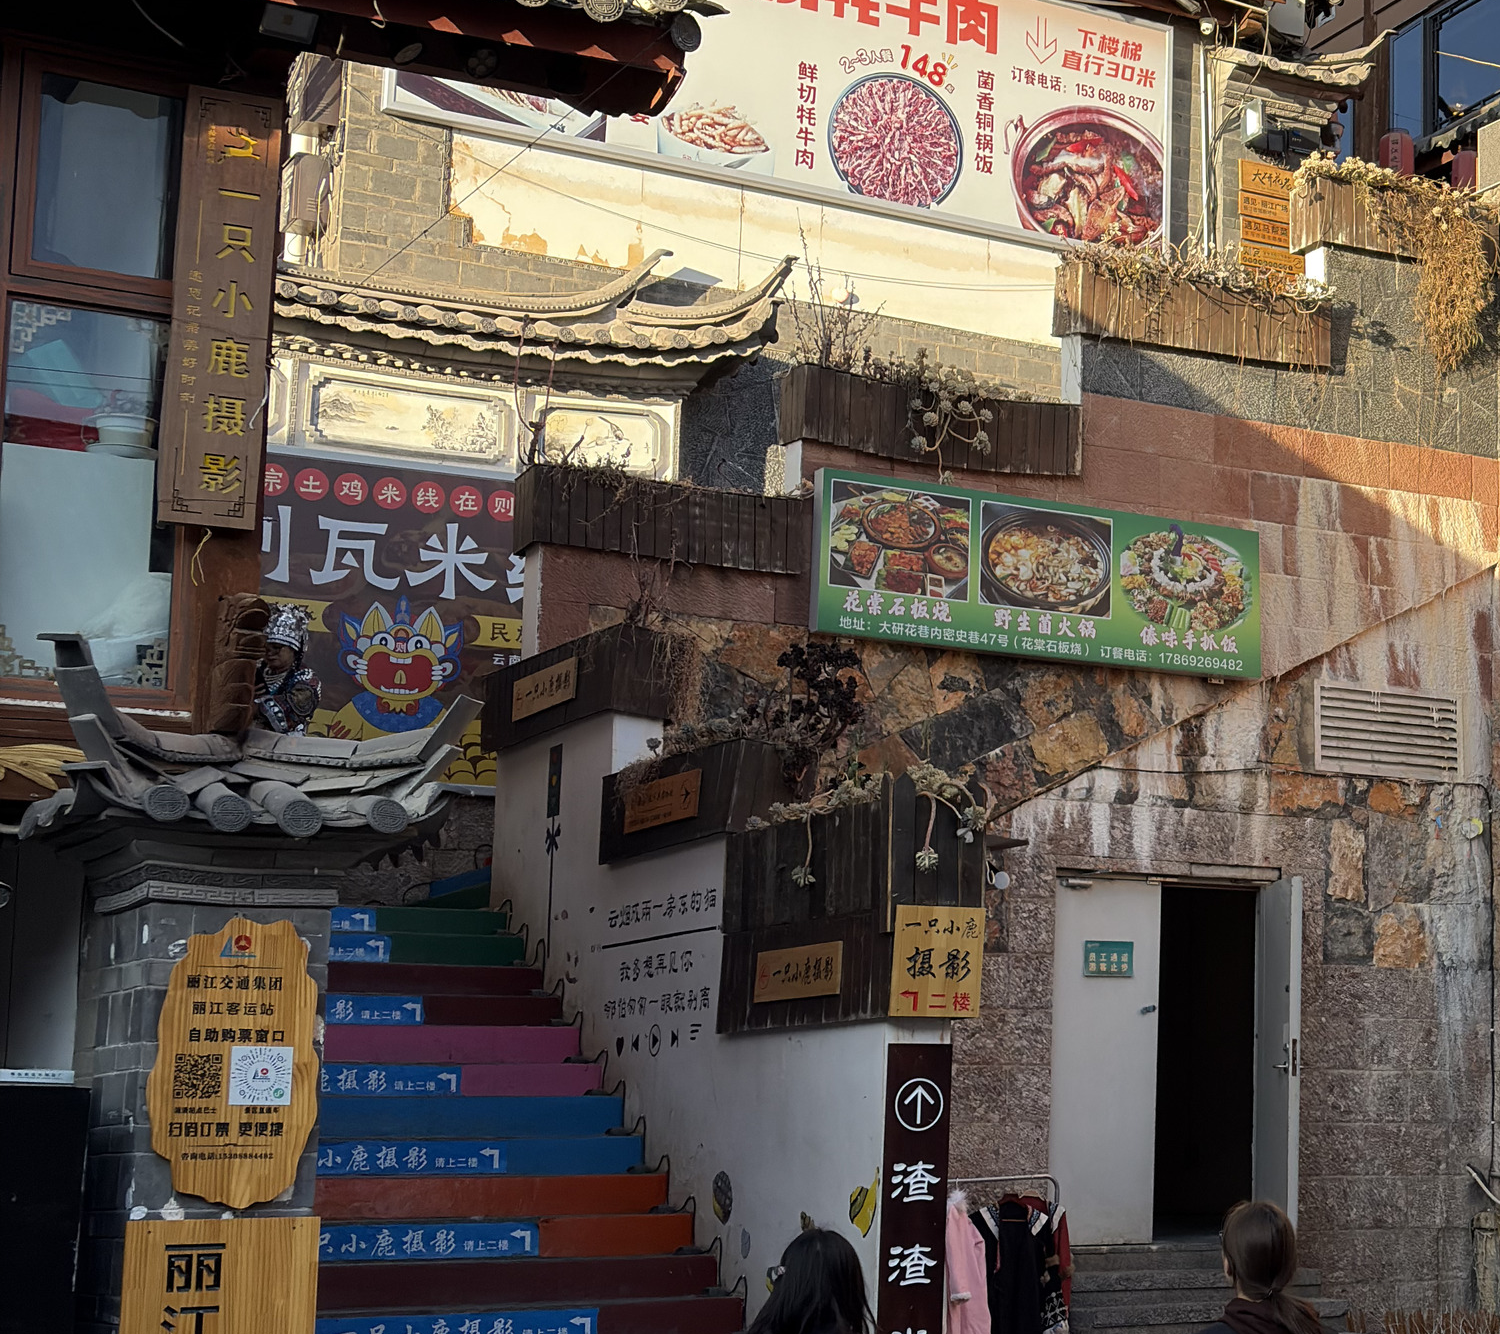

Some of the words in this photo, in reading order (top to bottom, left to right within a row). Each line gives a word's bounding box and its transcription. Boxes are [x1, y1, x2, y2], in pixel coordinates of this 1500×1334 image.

[1077, 28, 1143, 61] 下楼梯
[900, 44, 948, 88] 148
[1061, 49, 1156, 89] 直行30米
[1097, 88, 1126, 107] 6888
[1127, 95, 1155, 114] 8787
[794, 61, 819, 170] 鲜切牦牛肉
[974, 69, 996, 175] 菌香铜锅饭
[199, 186, 262, 496] 一只小鹿摄影
[843, 590, 952, 623] 花棠石板烧
[994, 608, 1097, 639] 野生菌火锅
[1140, 625, 1239, 654] 傣味手抓饭
[904, 917, 982, 940] 一只小鹿
[772, 956, 835, 986] 一只小鹿摄影
[906, 947, 972, 983] 摄影
[187, 975, 282, 991] 丽江交通集团
[192, 1001, 275, 1016] 丽江客运站
[331, 1000, 354, 1021] 影
[361, 1009, 401, 1021] 请上二楼
[929, 992, 972, 1011] 二楼
[188, 1027, 285, 1044] 自助购票窗口
[394, 1080, 436, 1092] 请上二楼
[168, 1121, 230, 1137] 扫码订票
[239, 1121, 284, 1137] 更便捷
[318, 1144, 429, 1172] 小鹿摄影
[435, 1156, 478, 1169] 请上二楼
[463, 1237, 509, 1251] 请上二楼
